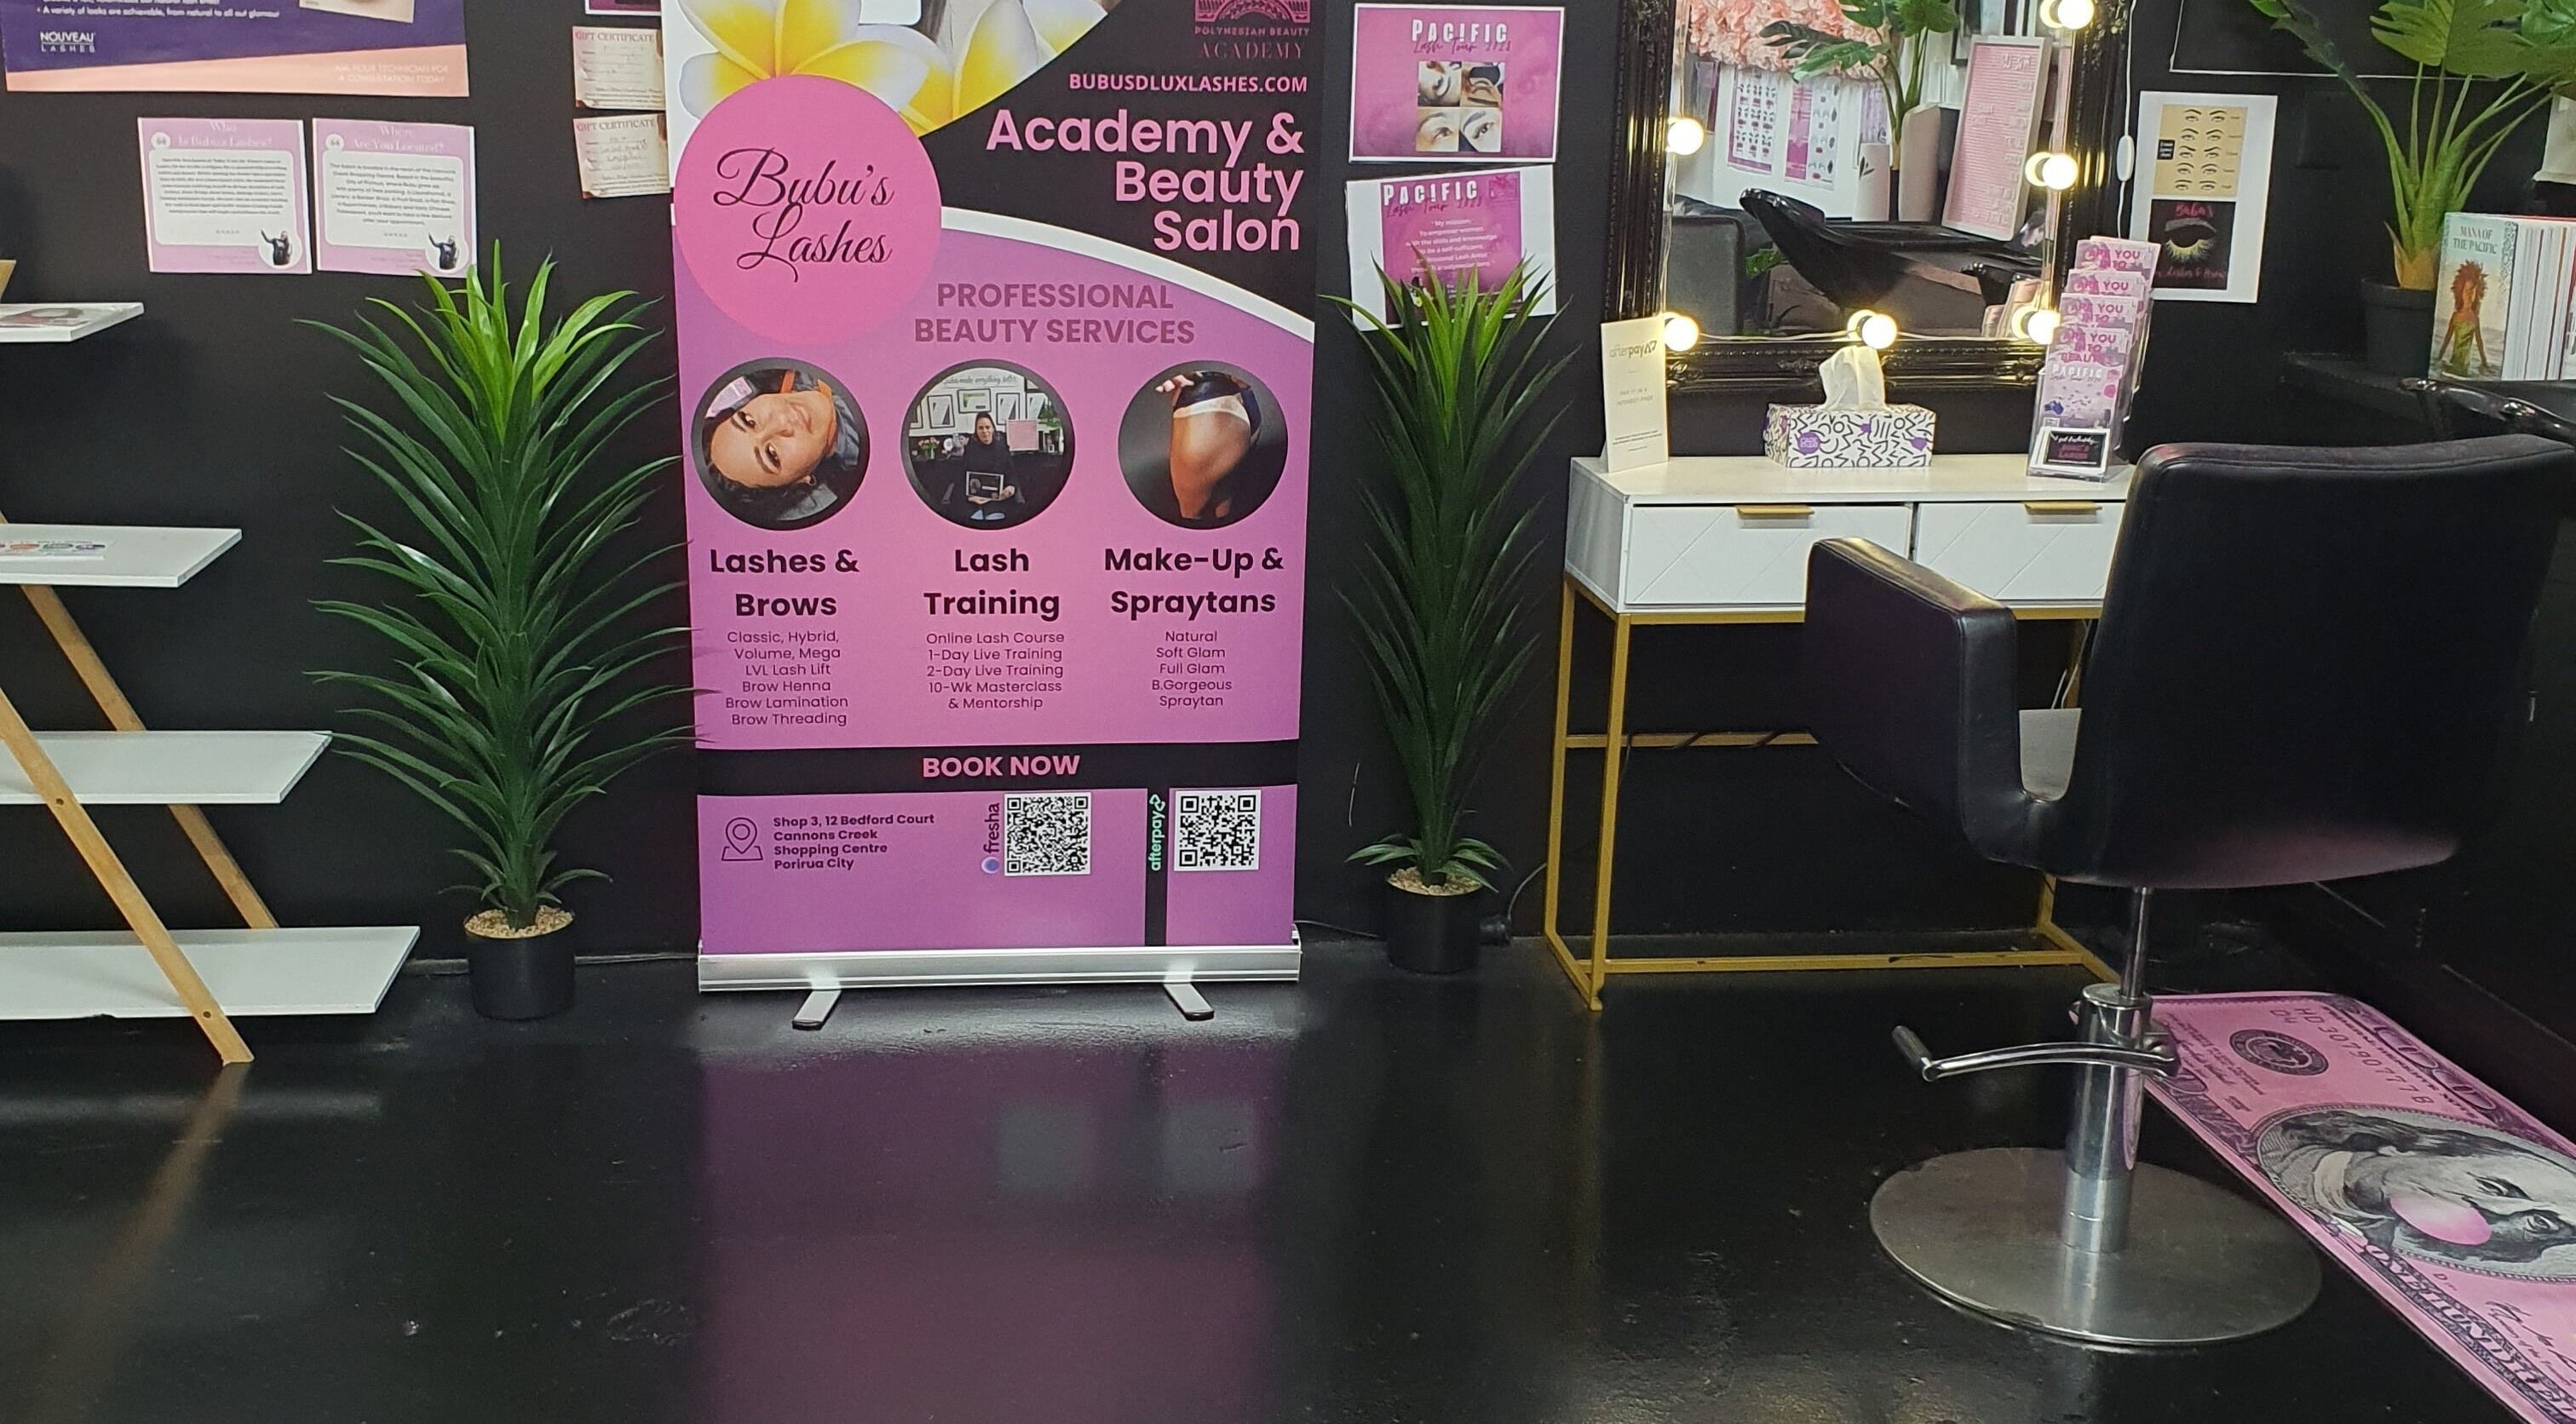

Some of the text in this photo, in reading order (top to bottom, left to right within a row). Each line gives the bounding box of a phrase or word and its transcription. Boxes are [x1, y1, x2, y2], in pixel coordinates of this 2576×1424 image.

[40, 32, 94, 43] NOUVEAU
[597, 32, 655, 43] CERTIFICATE
[1069, 73, 1308, 93] BUBUSDLUXLASHES.COM
[986, 108, 1305, 169] Academy &
[712, 146, 894, 207] Bubu's
[1115, 160, 1305, 217] Beauty
[1153, 209, 1300, 252] Salon
[736, 202, 893, 283] Lashes
[2114, 250, 2141, 260] YOU
[2103, 281, 2130, 291] YOU
[937, 283, 1174, 310] PROFESSIONAL
[2097, 303, 2124, 314] YOU
[914, 318, 1195, 345] BEAUTY SERVICES
[2090, 332, 2117, 344] YOU
[1609, 343, 1644, 359] afterpay
[710, 549, 860, 575] Lashes &
[954, 548, 1030, 573] Lash
[1104, 548, 1285, 577] Make-Up &
[734, 592, 837, 617] Brows
[924, 590, 1061, 622] Training
[1110, 589, 1276, 621] Spraytans
[727, 630, 839, 645] Classic, Hybrid,
[926, 632, 1065, 644] Online Lash Course
[1165, 630, 1217, 642] Natural
[734, 648, 841, 662] Volume, Mega
[929, 648, 1062, 663] 1-Day Live Training
[1156, 646, 1226, 658] Soft Glam
[745, 663, 831, 676] LVL Lash Lift
[927, 664, 1064, 679] 2-Day Live Training
[1159, 663, 1225, 675] Full Glam
[743, 680, 831, 692] Brow Henna
[929, 680, 1062, 693] 10-Wk Masterclass
[1152, 680, 1233, 693] B.Gorgeous
[726, 696, 848, 709] Brow Lamination
[948, 697, 1044, 710] & Mentorship
[1159, 696, 1223, 709] Spraytan
[732, 712, 847, 726] Brow Threading
[923, 755, 1080, 778] BOOK NOW
[773, 813, 934, 829] Shop 3, 12 Bedford Court
[983, 802, 1000, 854] fresha
[773, 829, 878, 841] Cannons Creek
[1148, 810, 1166, 871] afterpay
[774, 843, 888, 858] Shopping Centre
[774, 858, 854, 870] Porirua City
